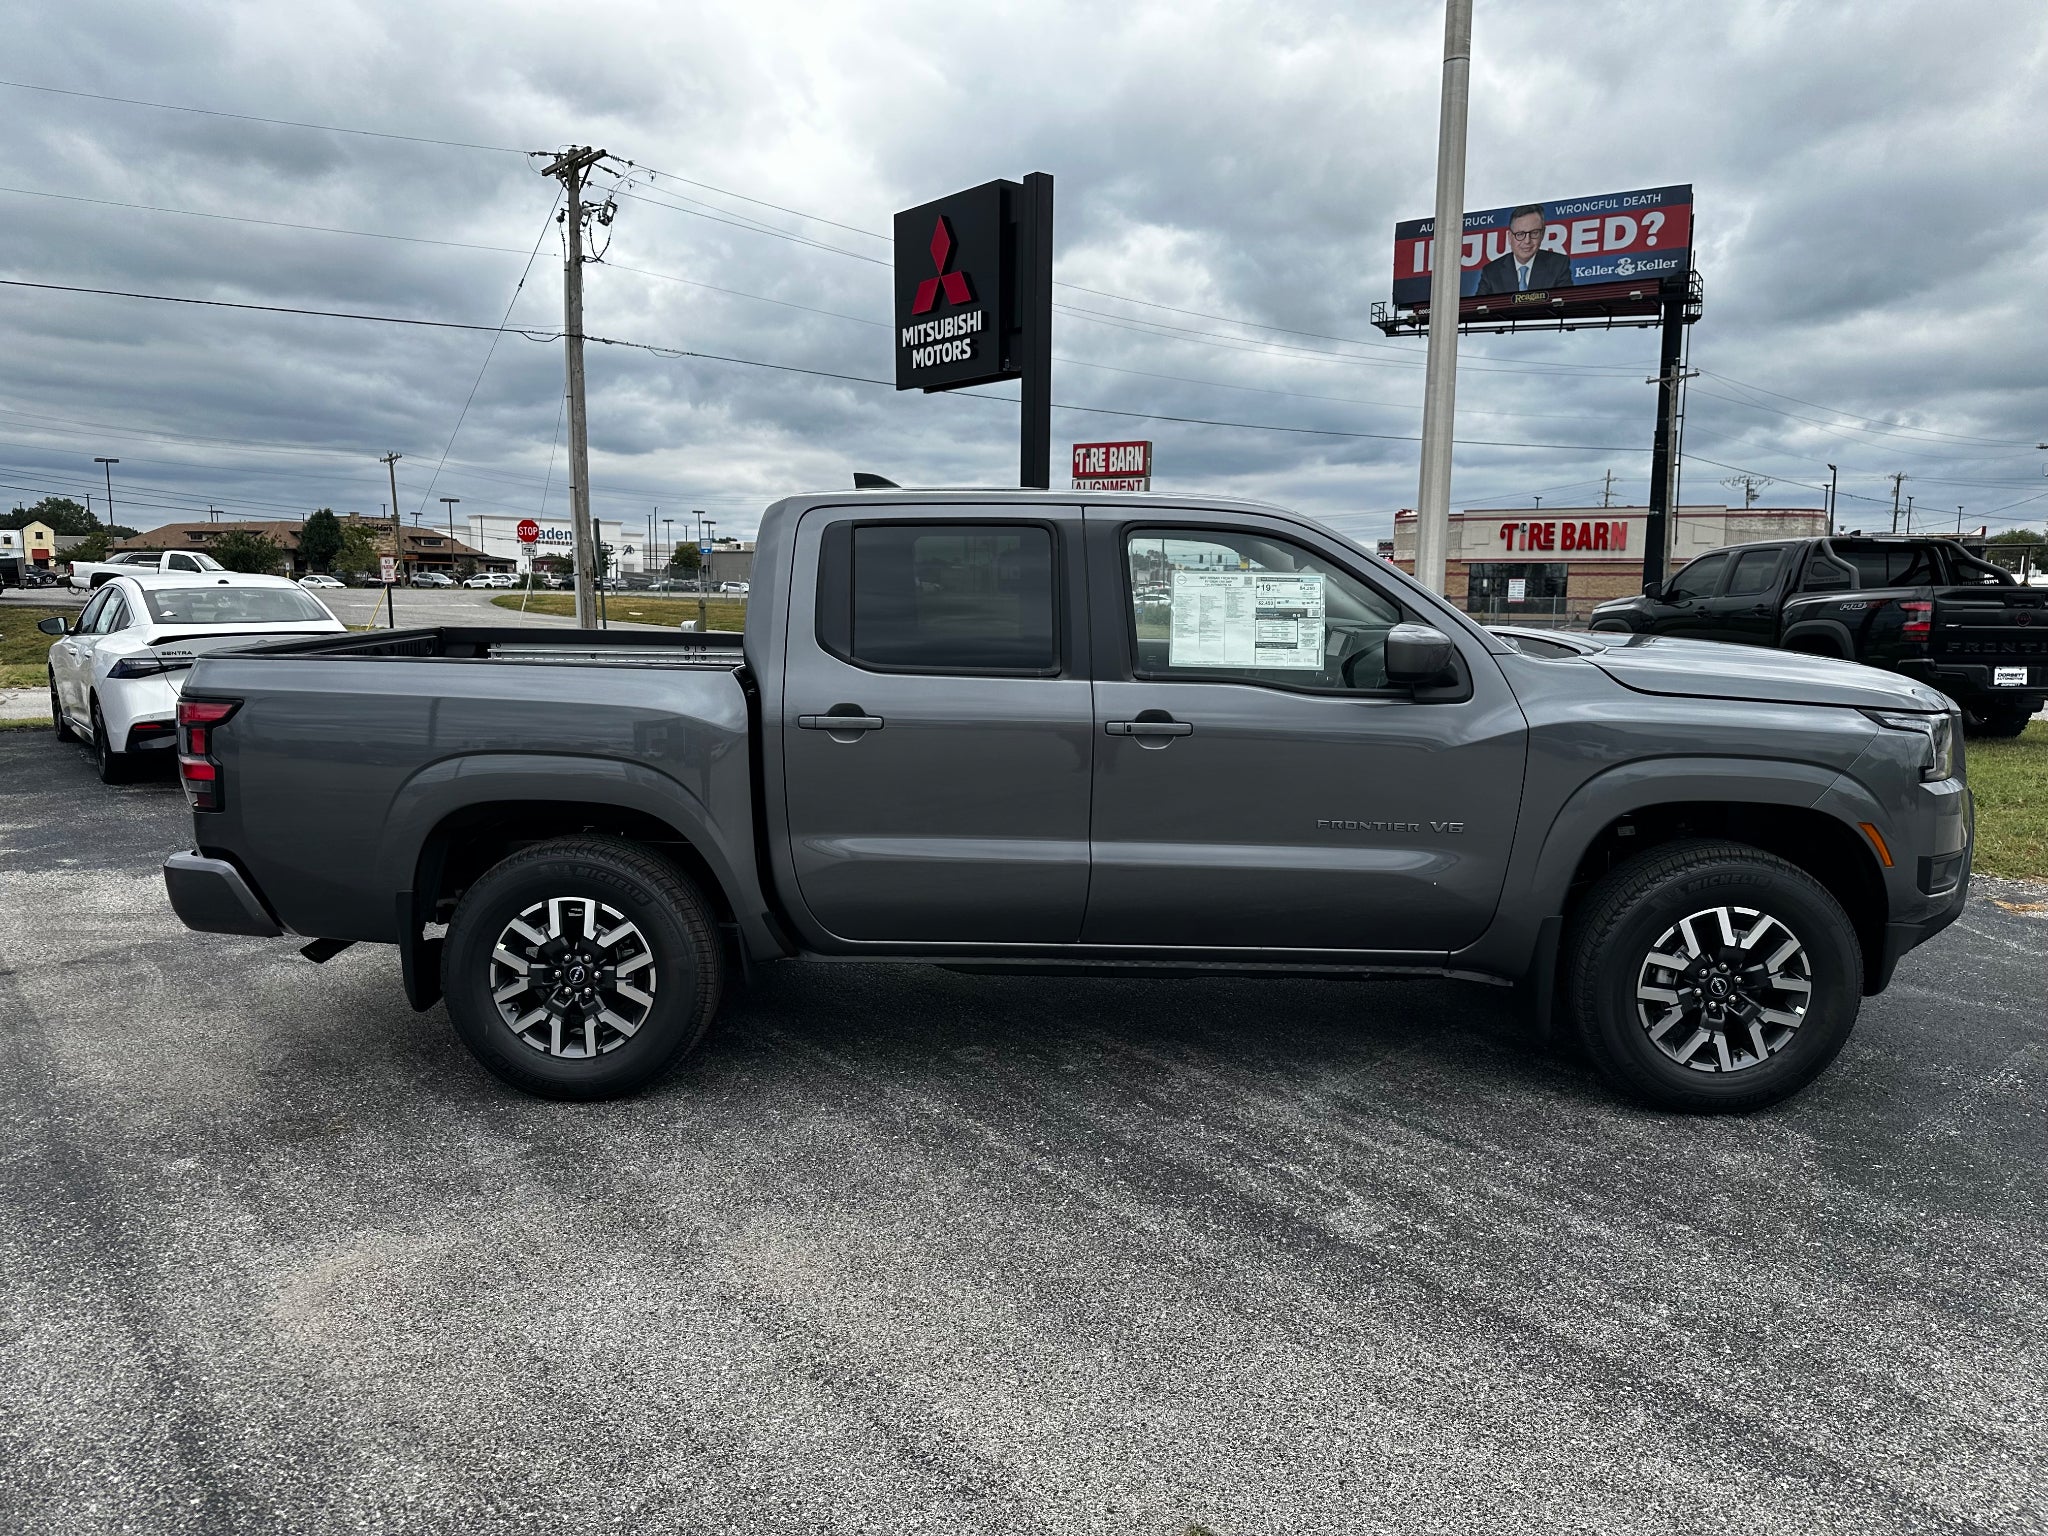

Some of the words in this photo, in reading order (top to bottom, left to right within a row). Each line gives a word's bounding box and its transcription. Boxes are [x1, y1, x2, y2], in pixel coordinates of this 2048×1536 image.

[1555, 199, 1618, 215] WRONGFUL
[1623, 193, 1662, 206] DEATH
[1413, 211, 1665, 273] IJURED?
[1575, 265, 1614, 278] Keller
[1636, 258, 1678, 272] Keller
[902, 310, 982, 348] MITSUBISHI
[912, 338, 972, 369] MOTORS
[1109, 445, 1144, 472] BARN
[518, 526, 538, 536] STOP
[1561, 521, 1628, 551] BARN
[1316, 819, 1420, 832] FRONTIER
[1429, 821, 1464, 833] V6
[575, 866, 653, 907] MICHELIN
[1687, 873, 1773, 893] MICHELIN
